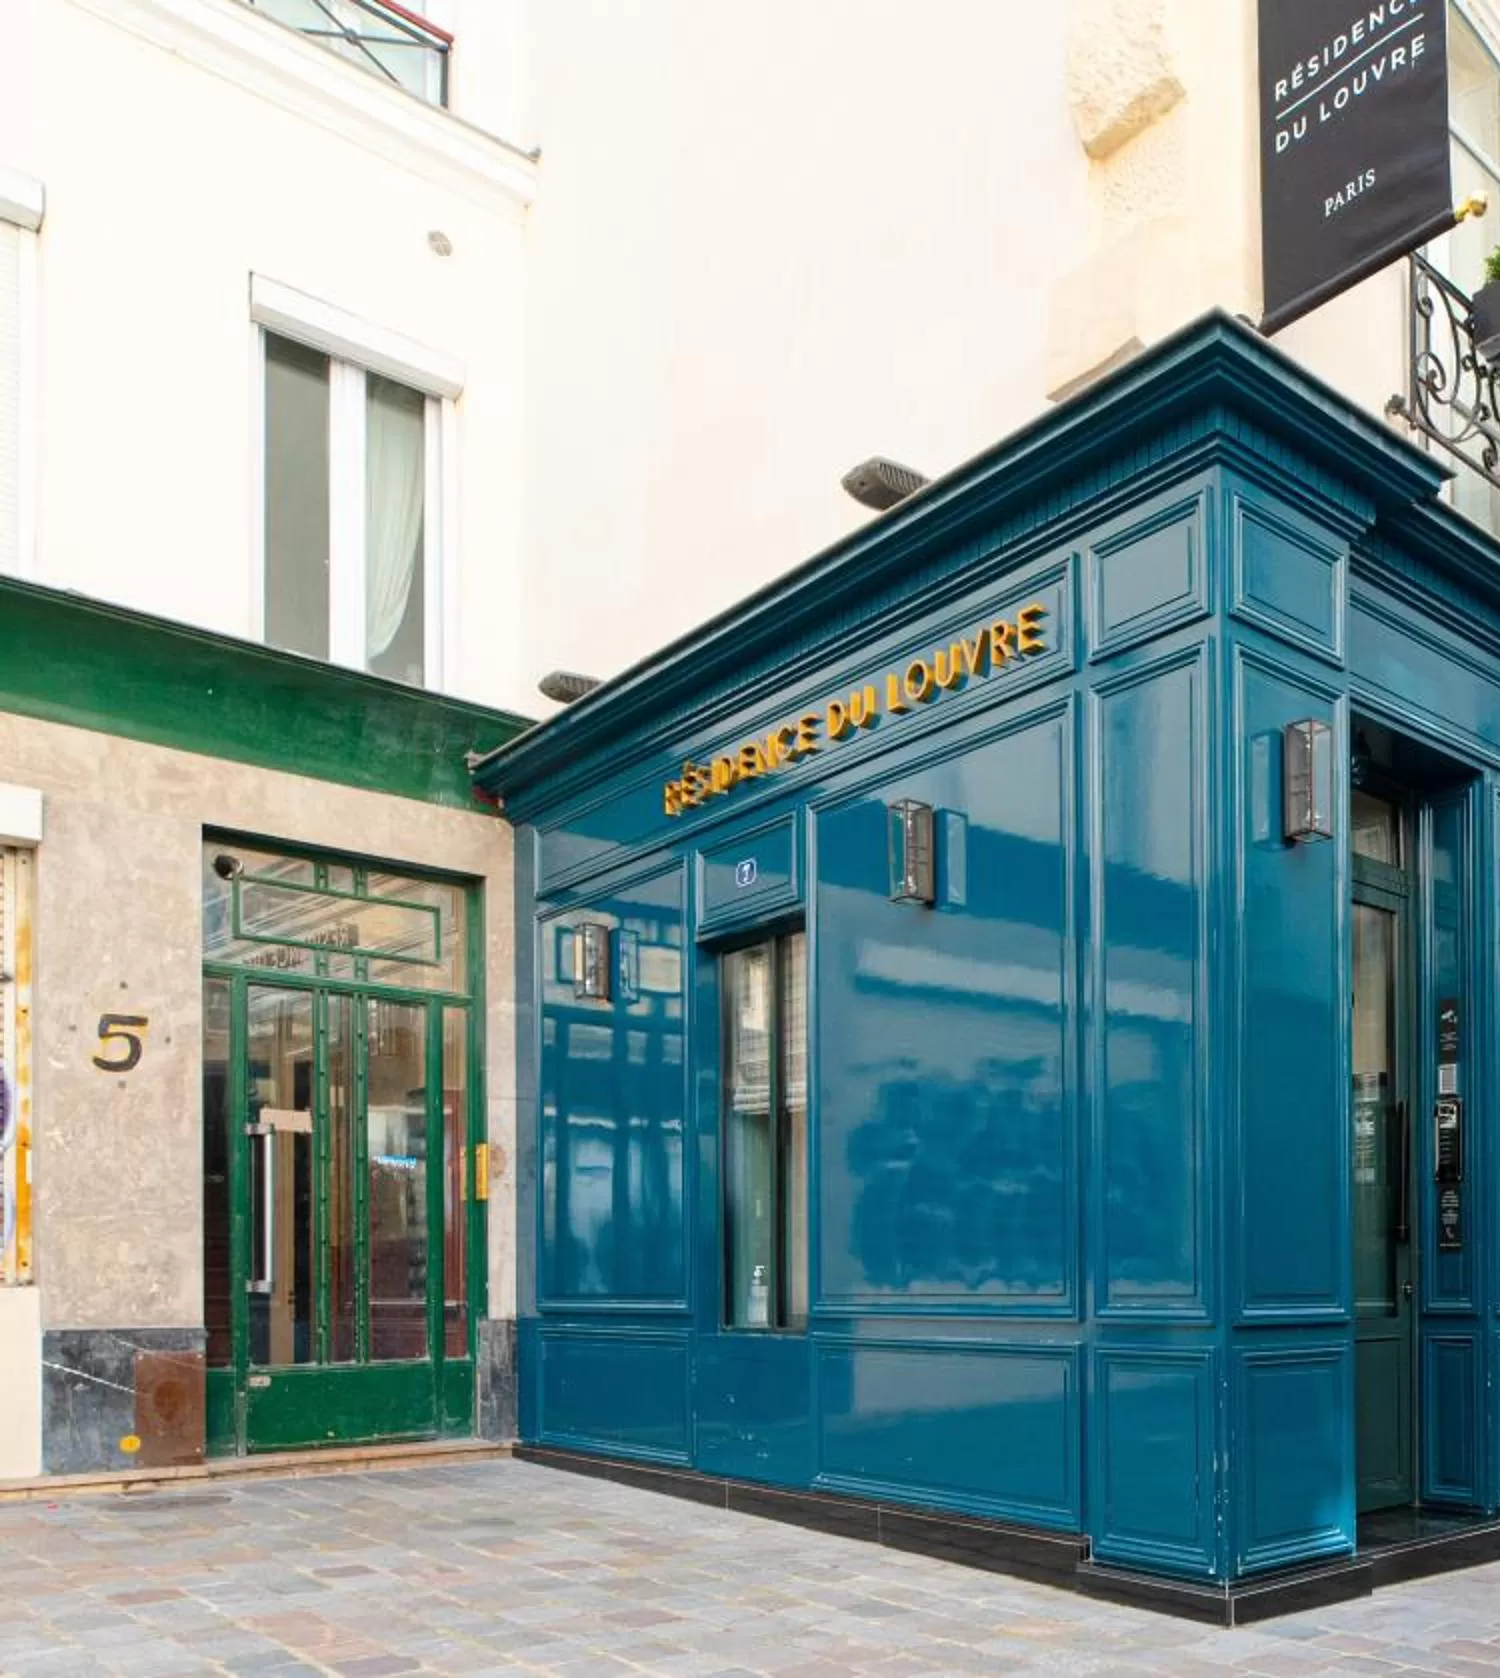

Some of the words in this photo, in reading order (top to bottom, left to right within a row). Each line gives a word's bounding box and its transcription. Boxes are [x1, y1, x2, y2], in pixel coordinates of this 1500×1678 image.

[1275, 0, 1417, 101] RÉSIDENC
[1275, 116, 1307, 153] DU
[1320, 34, 1425, 121] LOUVRE
[1324, 168, 1376, 217] PARIS
[664, 712, 823, 817] RÉSIDENCE
[827, 685, 876, 740] DU
[886, 603, 1047, 714] LOUVRE
[92, 1013, 148, 1072] 5
